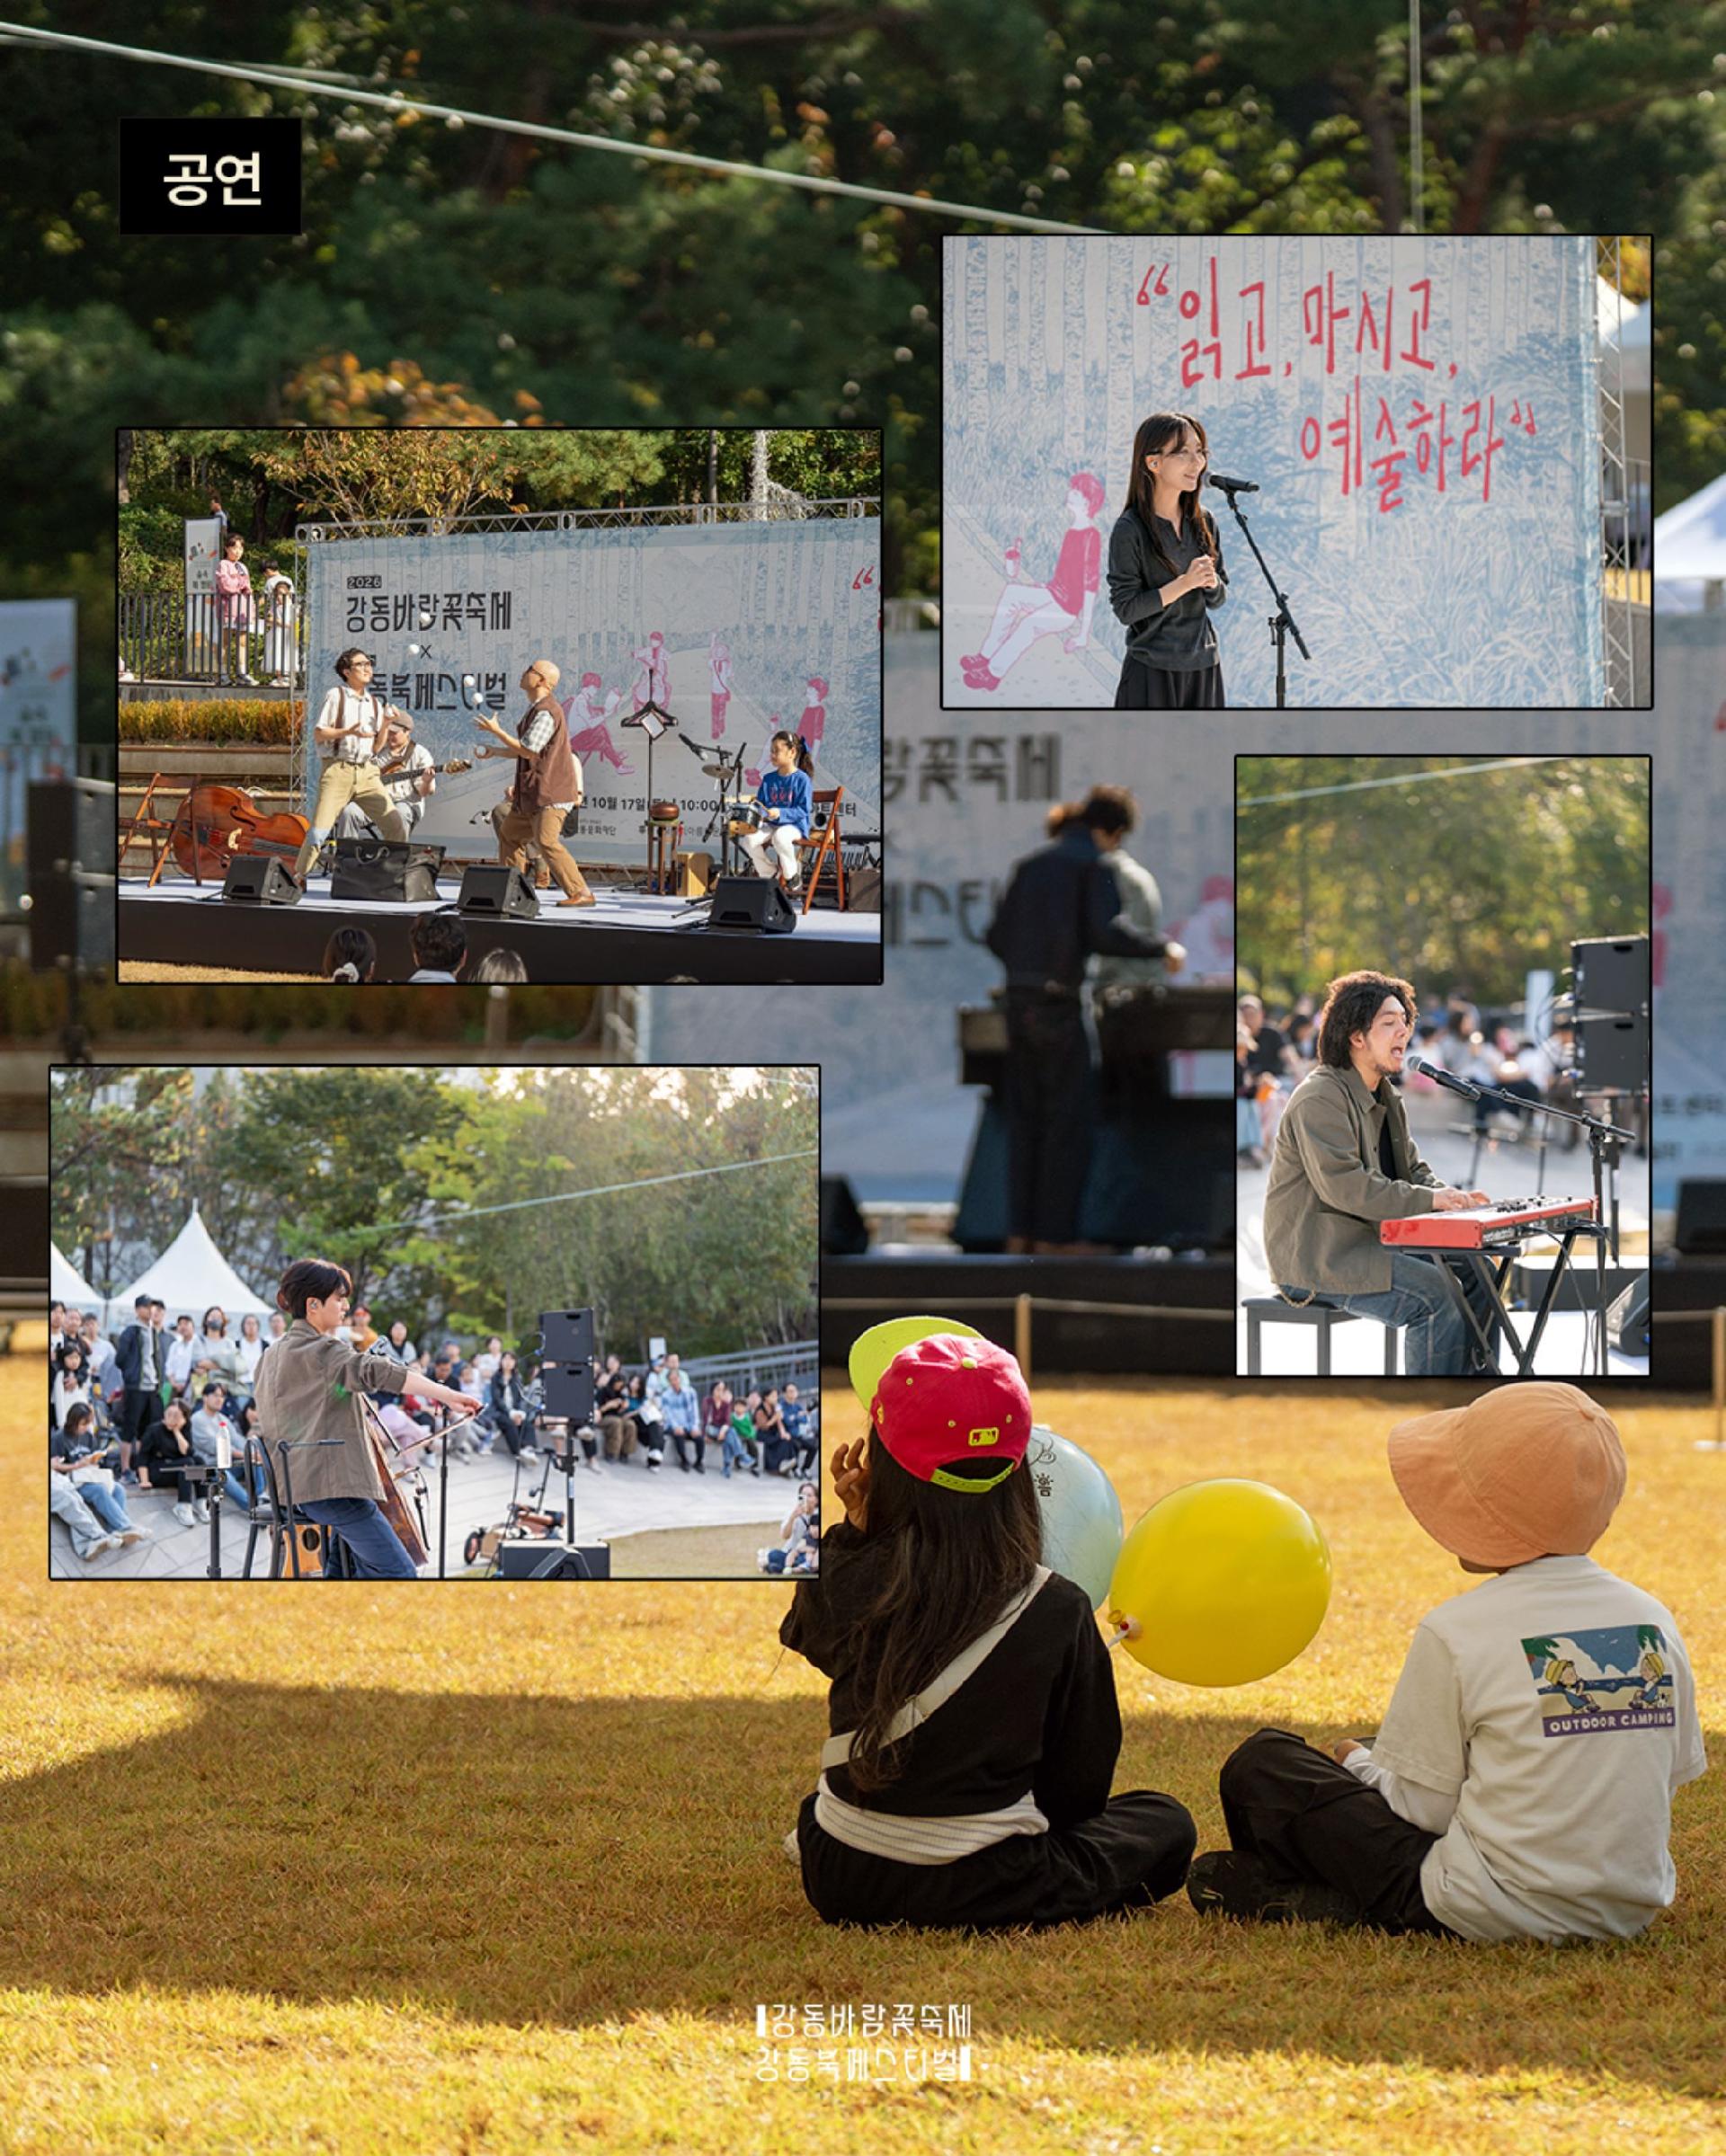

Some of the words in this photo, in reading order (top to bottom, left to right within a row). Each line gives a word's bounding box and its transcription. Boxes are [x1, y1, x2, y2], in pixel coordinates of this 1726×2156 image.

[1303, 271, 1458, 382] 마시고,
[348, 576, 381, 590] 2026
[347, 590, 512, 633] 강동바람꽃축제
[369, 672, 507, 711] 동북페스티벌
[1550, 1715, 1617, 1734] OUTDOOR
[1620, 1711, 1674, 1726] CAMPING
